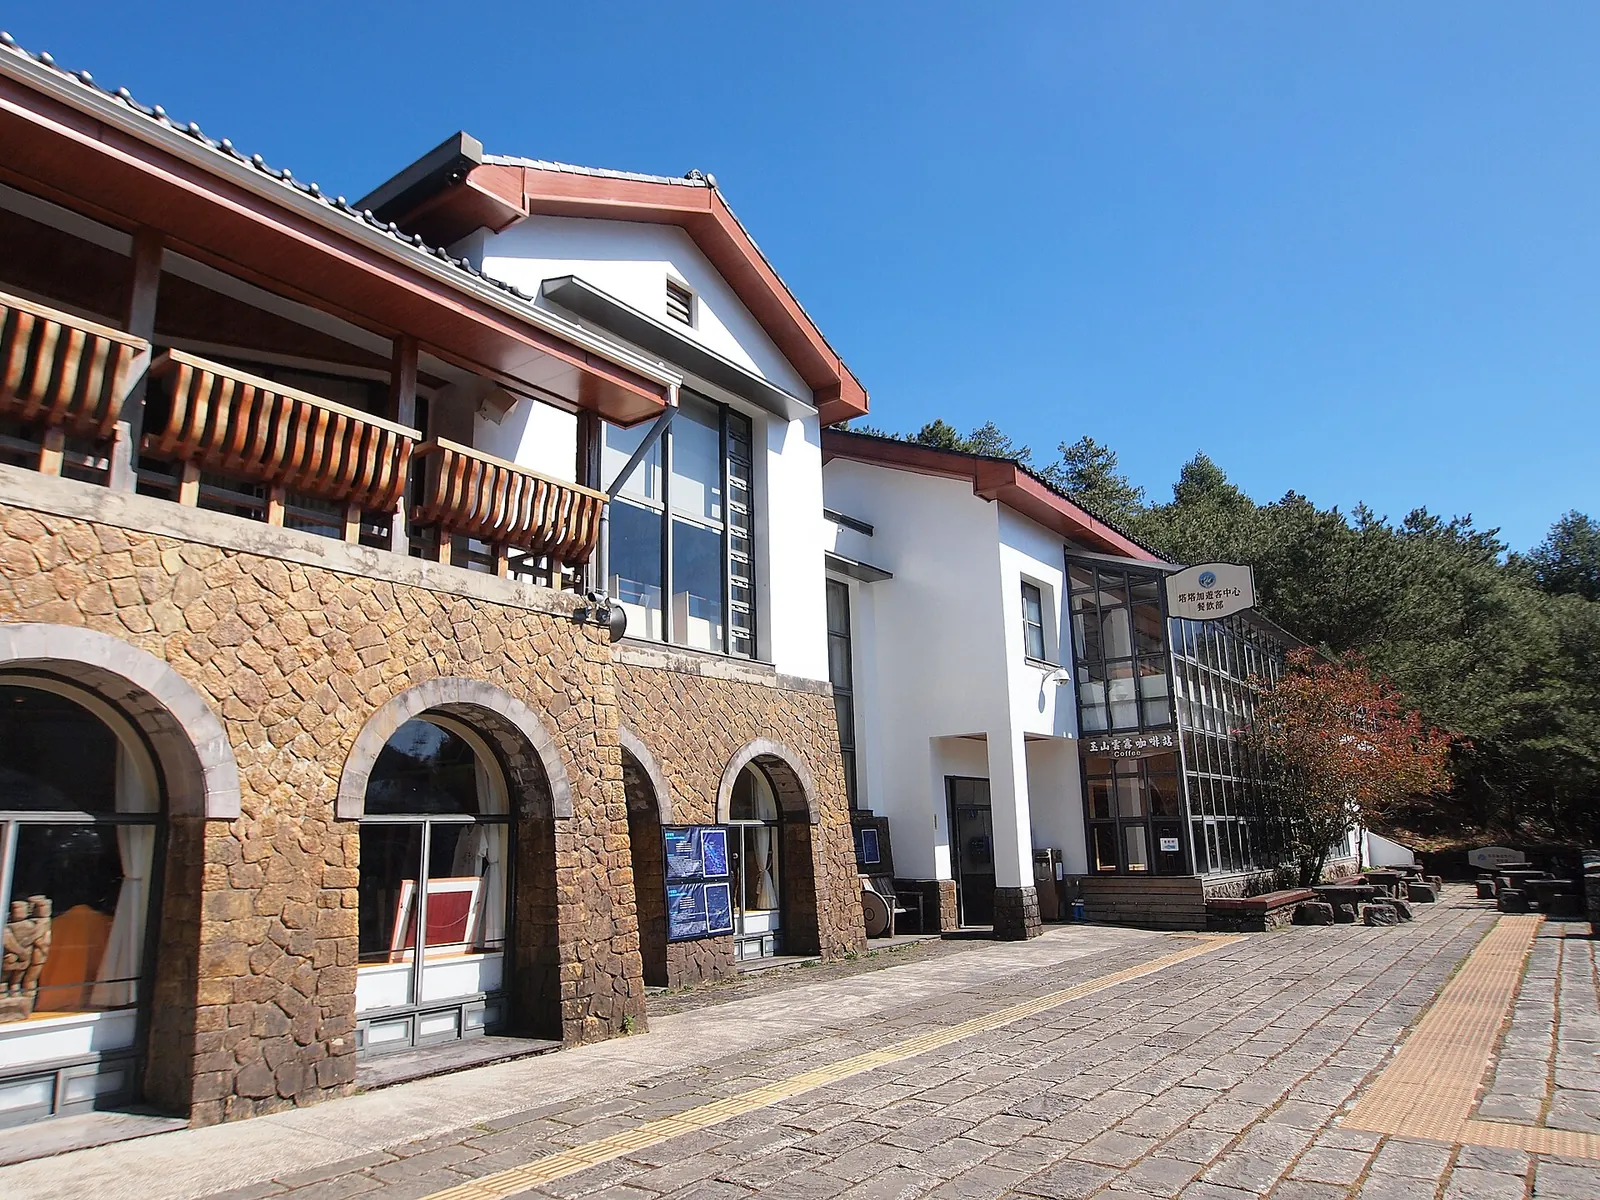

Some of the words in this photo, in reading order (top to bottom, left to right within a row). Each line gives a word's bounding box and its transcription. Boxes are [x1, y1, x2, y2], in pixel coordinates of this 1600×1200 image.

[1178, 587, 1241, 603] 塔塔加遊客中心
[1197, 600, 1224, 612] 餐飲部
[1113, 750, 1141, 758] Coffee
